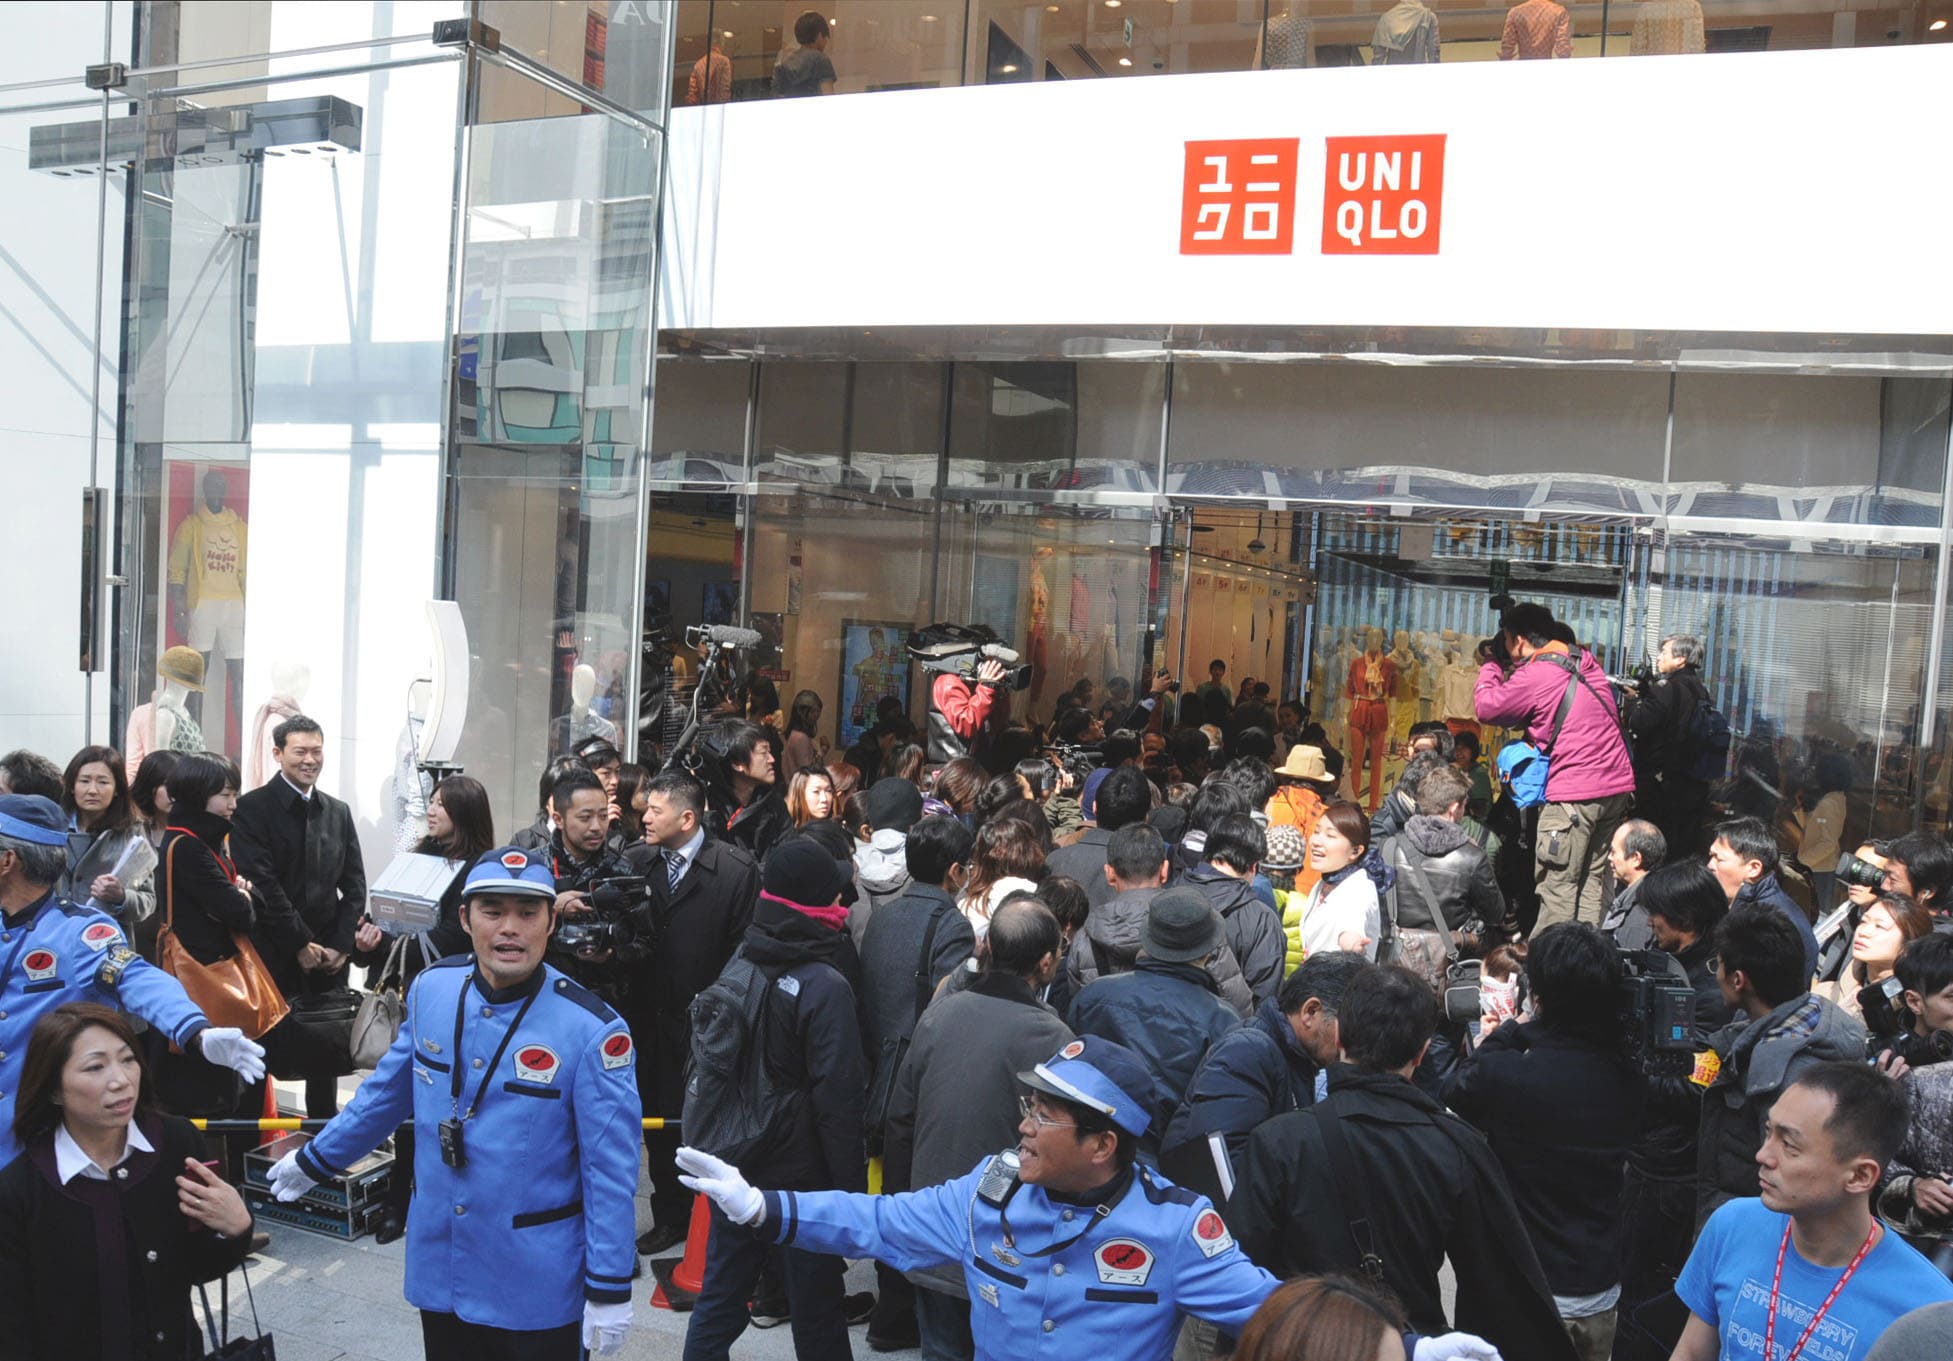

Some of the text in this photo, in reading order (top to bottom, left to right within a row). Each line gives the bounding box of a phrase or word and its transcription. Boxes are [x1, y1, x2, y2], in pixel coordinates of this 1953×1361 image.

[1198, 154, 1281, 193] ユニ
[1338, 150, 1423, 192] UNI
[1192, 202, 1280, 241] クロ
[1336, 199, 1428, 246] QLO
[520, 1071, 549, 1082] アース
[1103, 1272, 1142, 1284] アース
